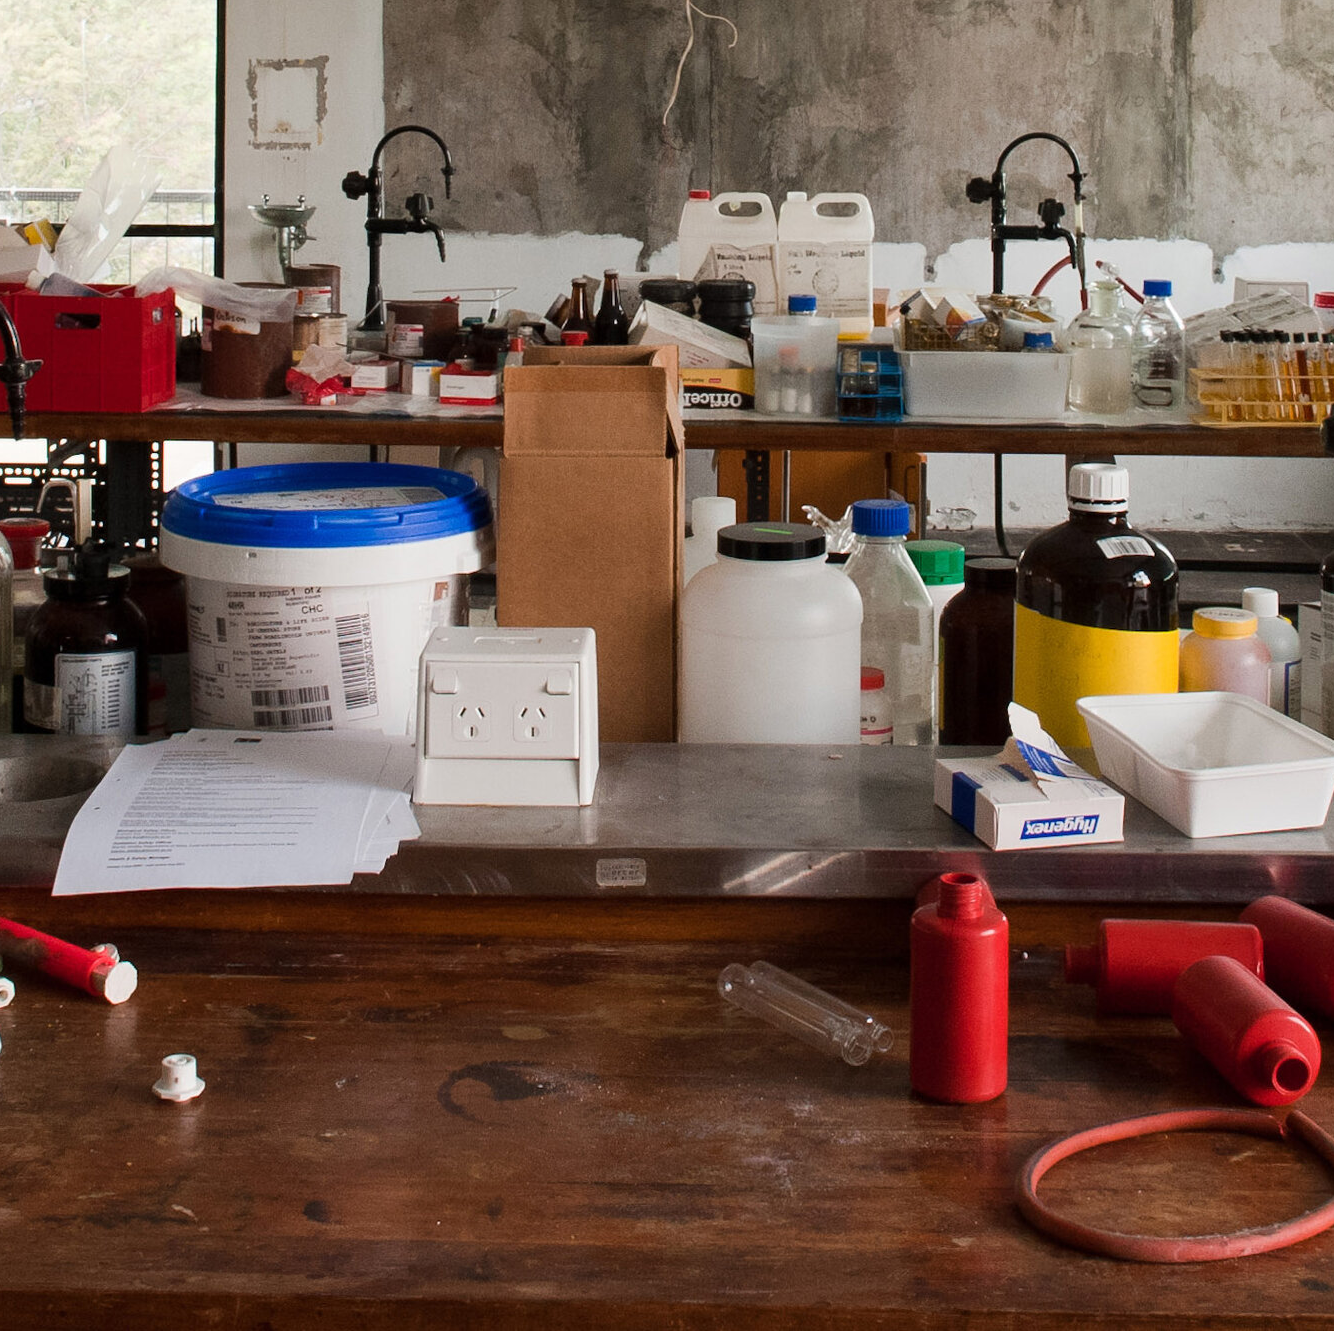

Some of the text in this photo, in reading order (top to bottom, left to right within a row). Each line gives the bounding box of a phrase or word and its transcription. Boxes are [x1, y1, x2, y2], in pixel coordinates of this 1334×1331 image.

[841, 250, 865, 259] Liquid
[291, 587, 296, 596] 1
[304, 587, 314, 595] of
[301, 604, 324, 615] CHC
[1025, 816, 1096, 835] Hygenex
